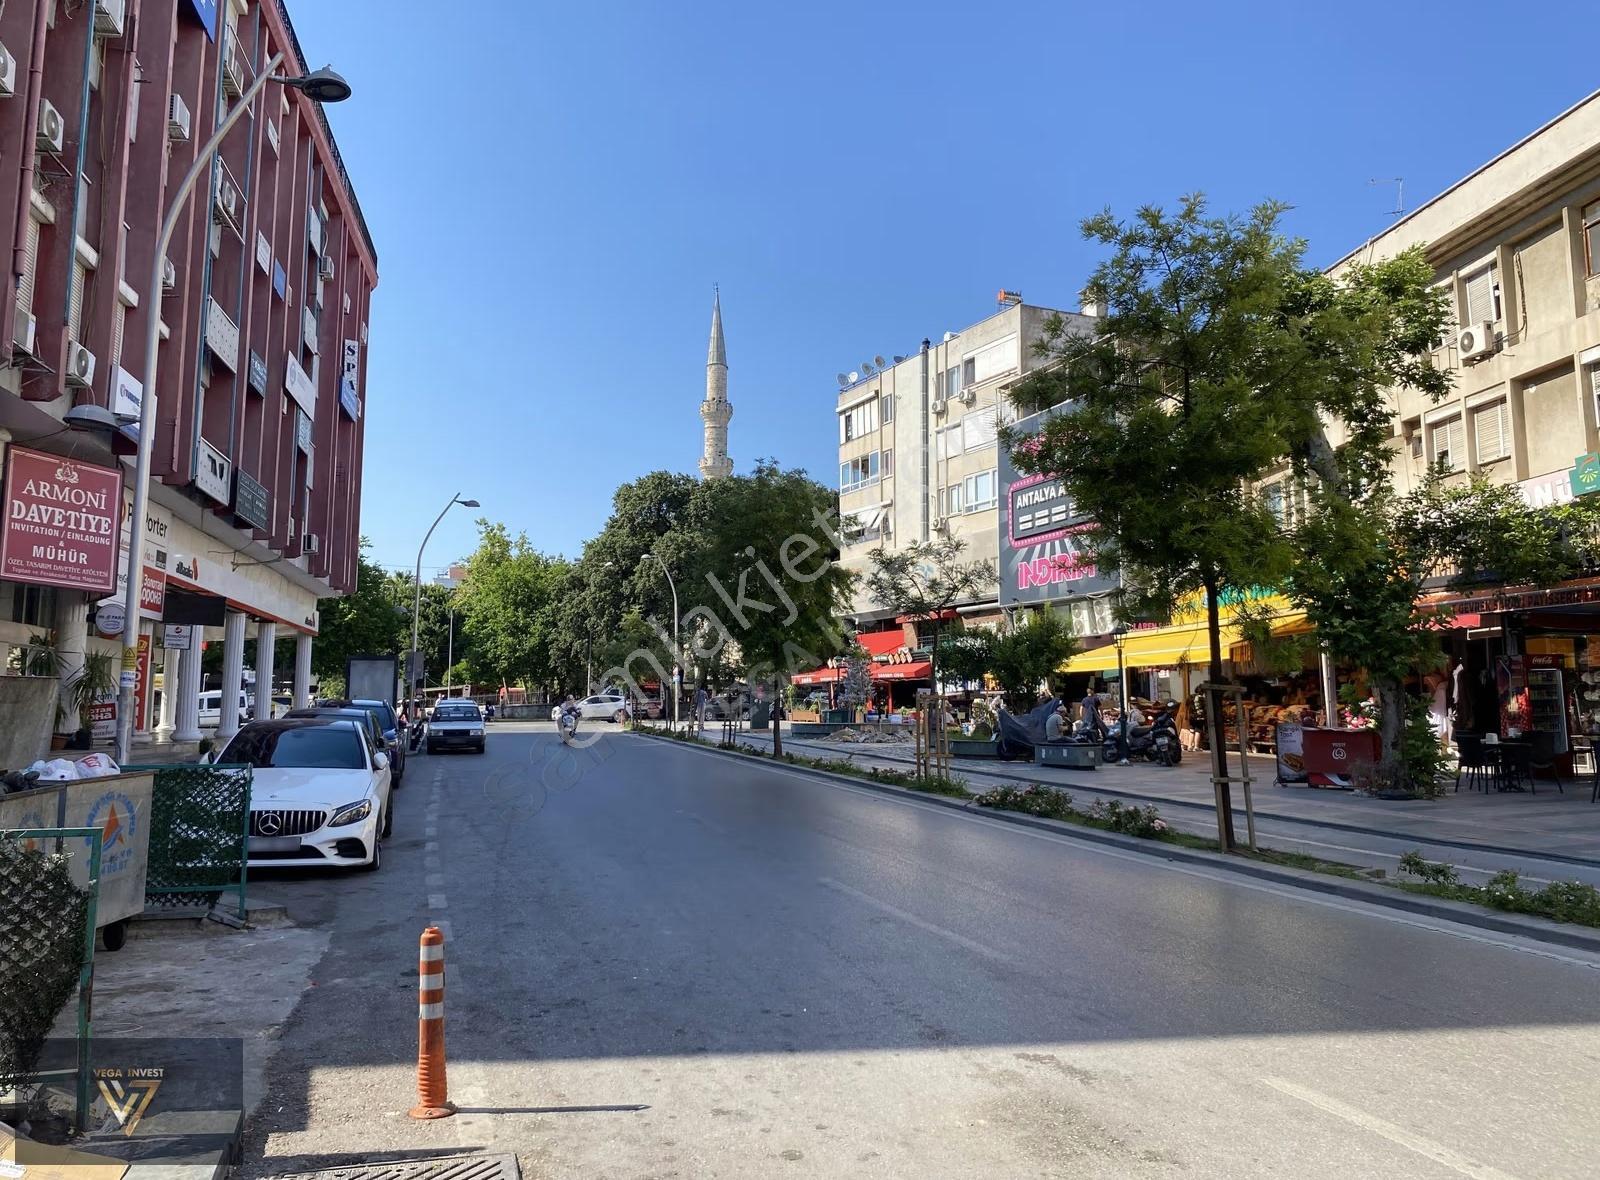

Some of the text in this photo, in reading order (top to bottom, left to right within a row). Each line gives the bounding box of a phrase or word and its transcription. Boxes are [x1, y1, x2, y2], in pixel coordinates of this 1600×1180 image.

[22, 479, 107, 510] ARMONİ
[1017, 486, 1056, 509] ANTALYA
[11, 500, 112, 535] DAVETİYE
[11, 522, 59, 538] INVITATION
[67, 531, 111, 546] EINLADUNG
[32, 545, 88, 565] MÜHÜR
